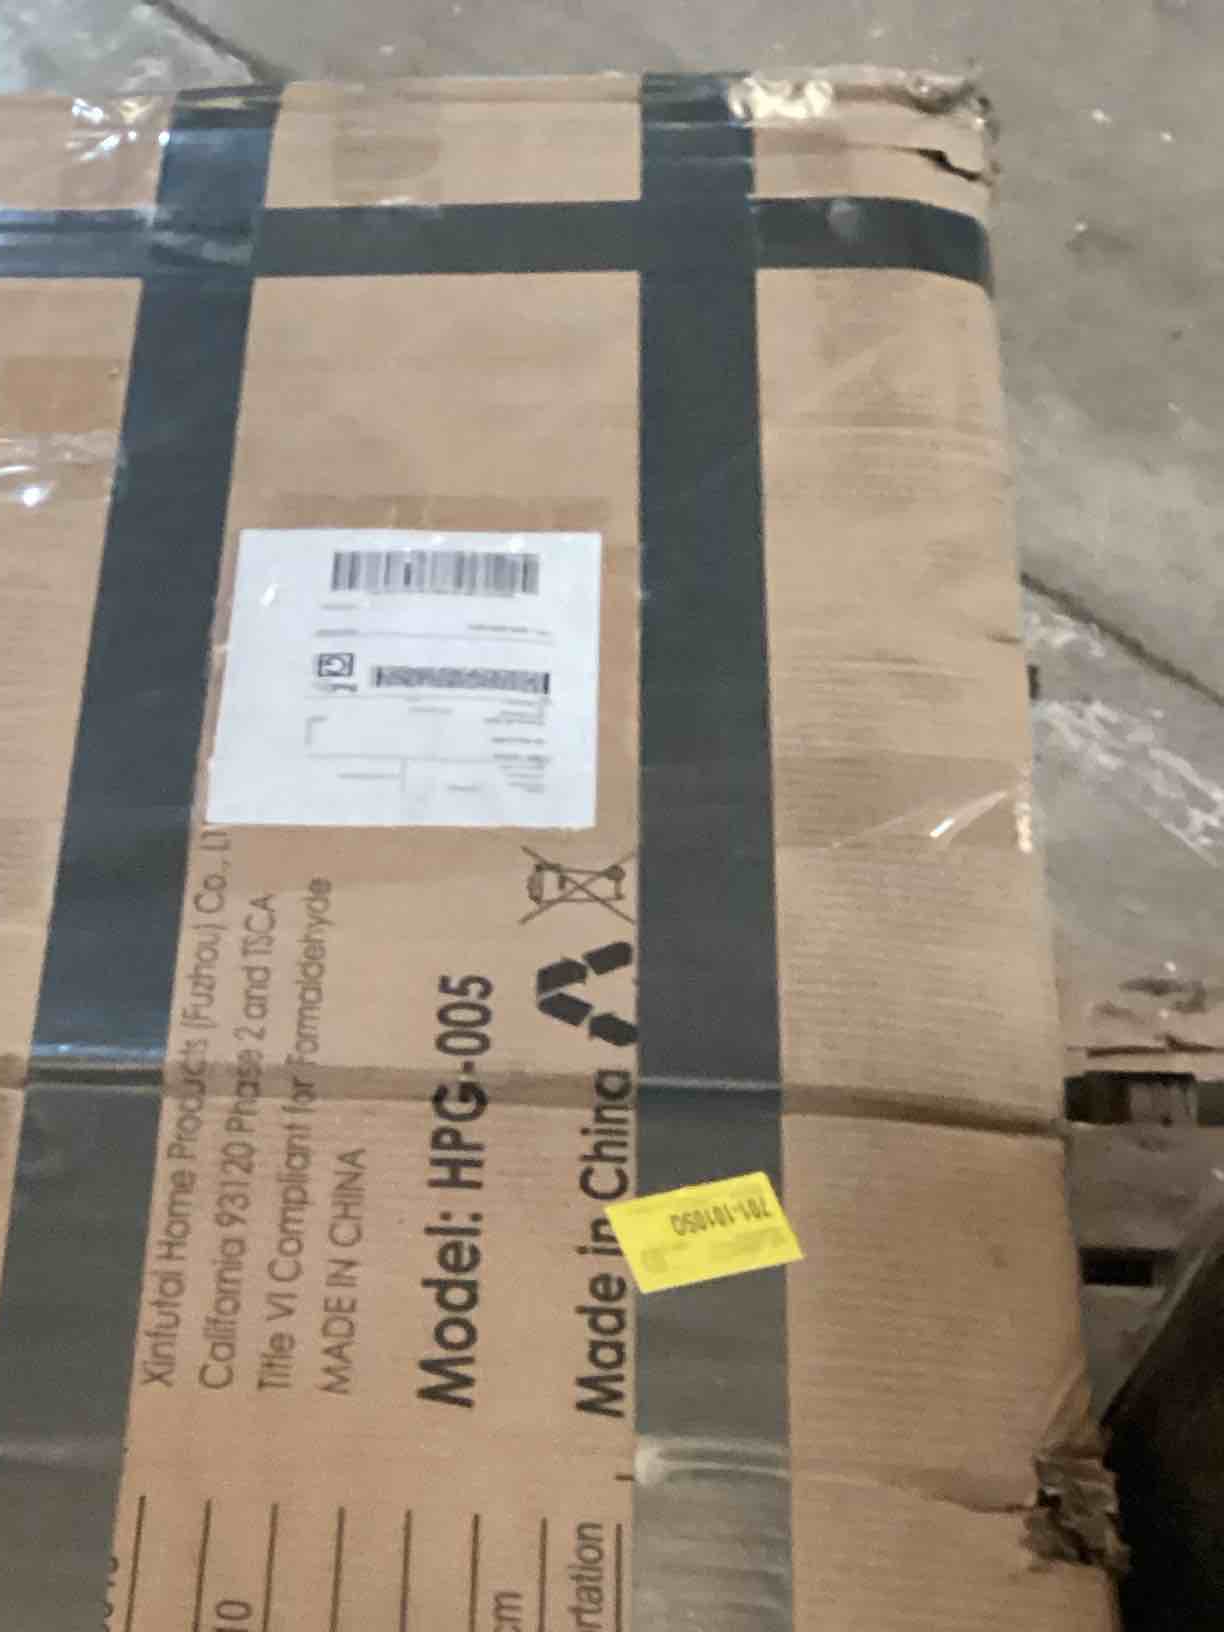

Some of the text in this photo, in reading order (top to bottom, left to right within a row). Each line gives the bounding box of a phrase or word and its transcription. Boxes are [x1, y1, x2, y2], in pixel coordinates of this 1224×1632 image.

[166, 1039, 208, 1160] Products
[180, 923, 230, 1029] (Fuzhou)
[155, 1169, 196, 1261] Home
[198, 894, 276, 1391] California 93120 Phase 2 and TSCA
[257, 878, 333, 1391] Title VI Compliant for Formaldehyde
[416, 975, 493, 1409] Model: HPG-005
[574, 1070, 631, 1419] Made in China
[141, 1271, 185, 1387] Xinfutai
[314, 1148, 366, 1395] MADE IN CHINA
